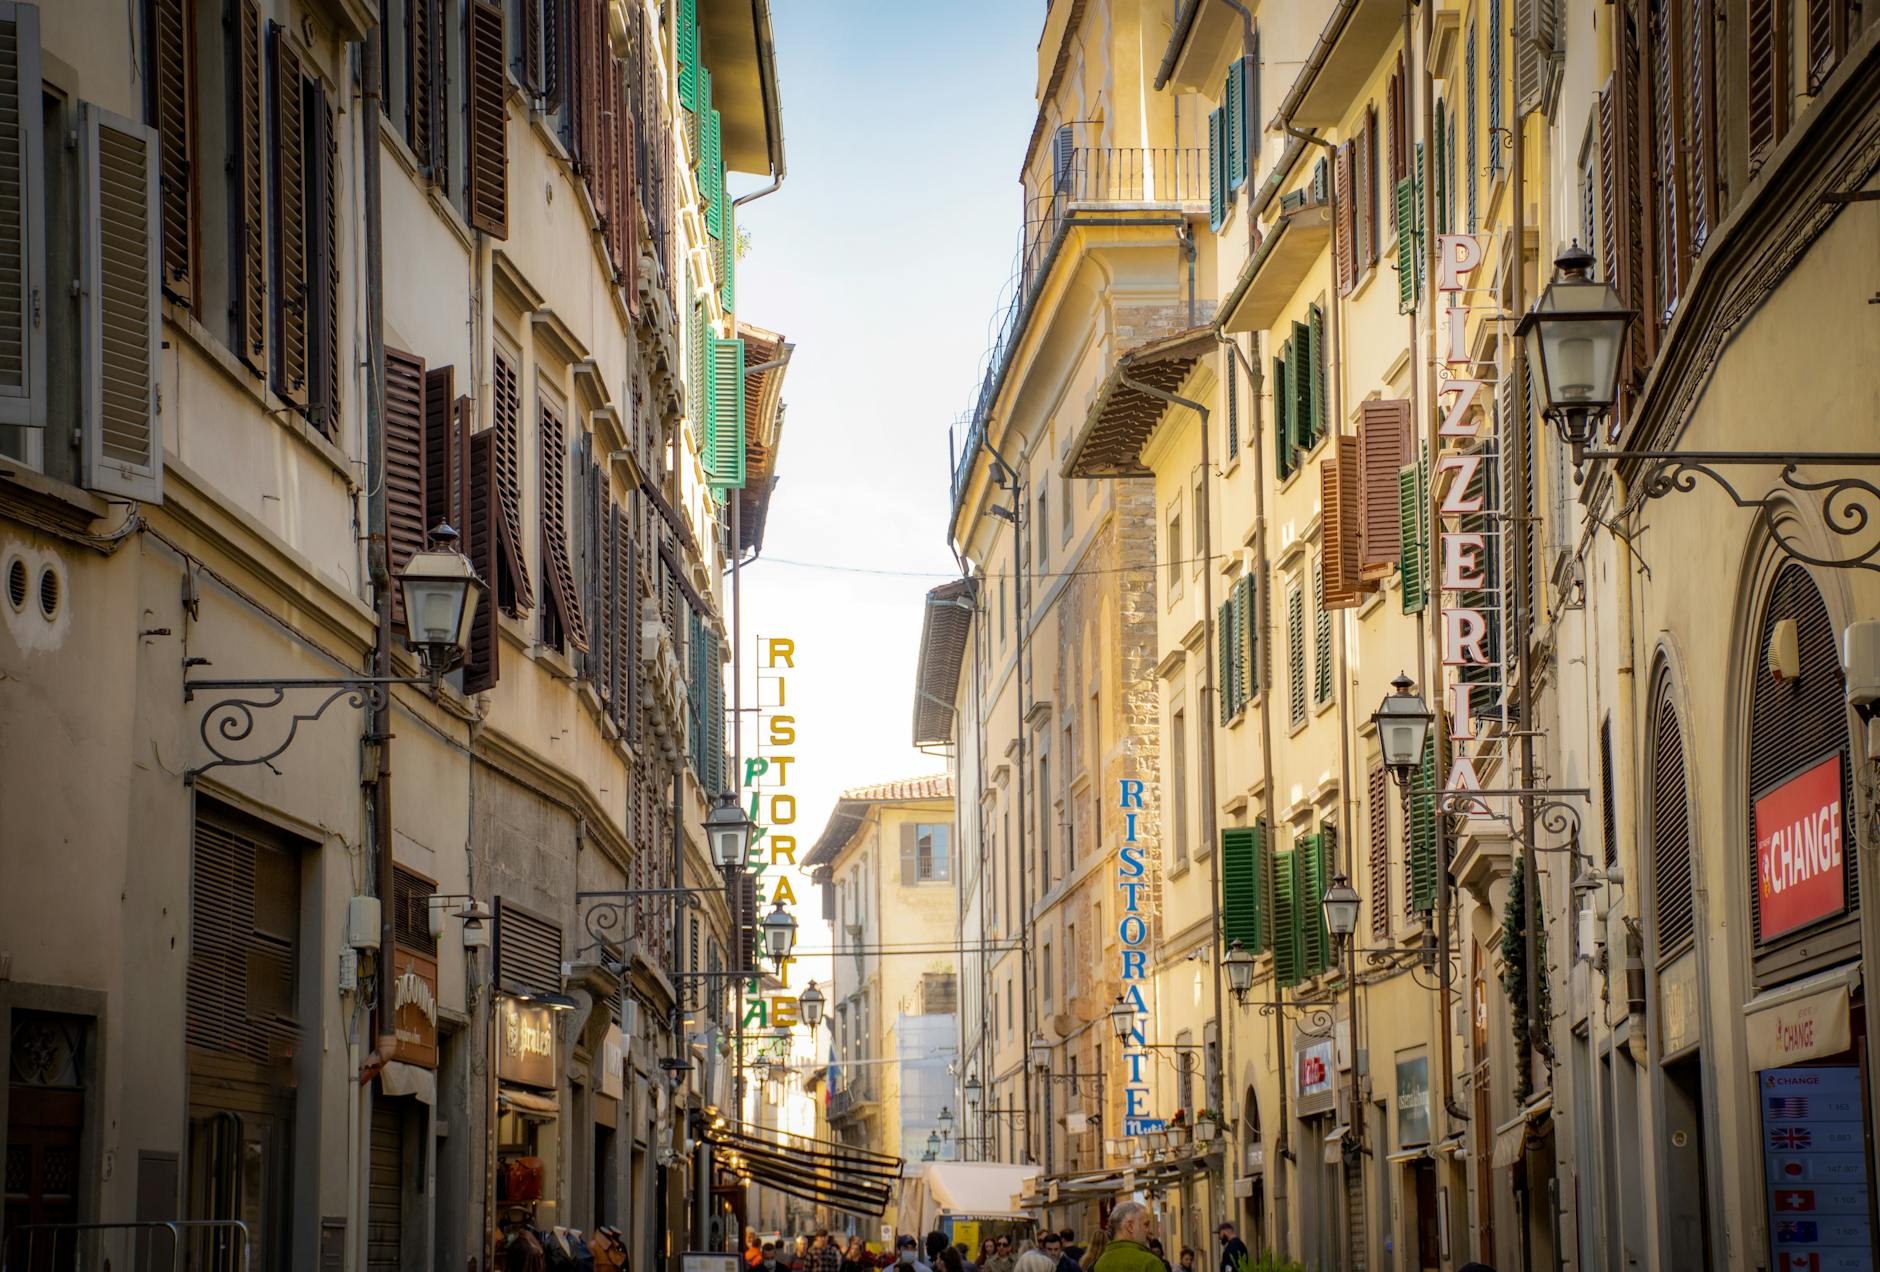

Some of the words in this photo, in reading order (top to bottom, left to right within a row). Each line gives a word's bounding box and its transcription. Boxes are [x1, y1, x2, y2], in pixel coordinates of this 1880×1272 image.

[1437, 233, 1489, 815] PIZZERIA
[768, 637, 798, 1028] RISTORATE
[1771, 801, 1841, 894] CHANGE
[1118, 778, 1150, 1118] RISTORANTE
[1783, 1020, 1815, 1052] CHANGE
[1776, 1076, 1821, 1086] CHANGE
